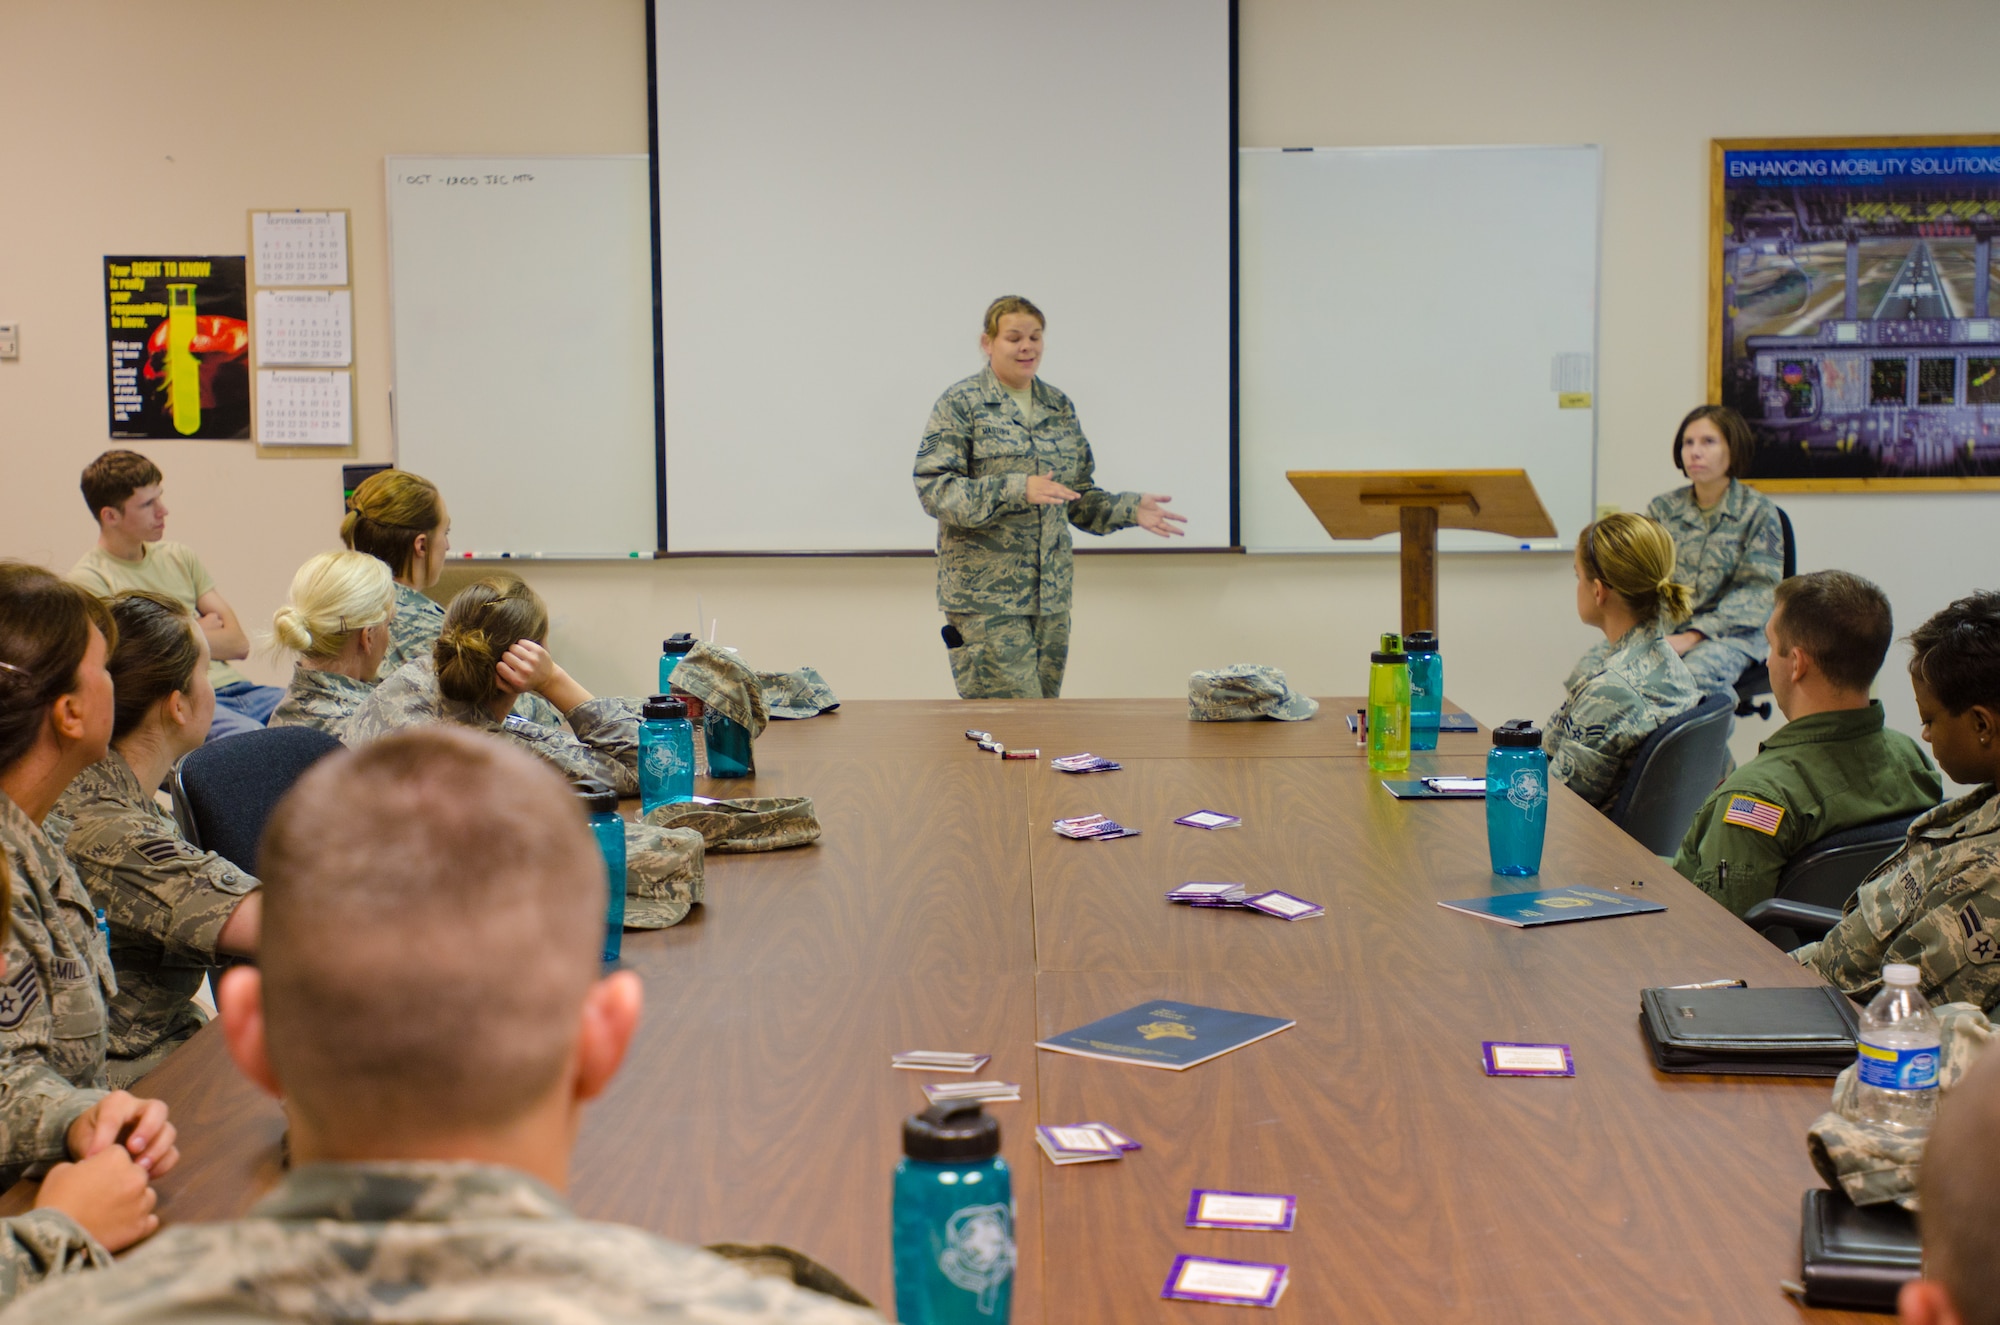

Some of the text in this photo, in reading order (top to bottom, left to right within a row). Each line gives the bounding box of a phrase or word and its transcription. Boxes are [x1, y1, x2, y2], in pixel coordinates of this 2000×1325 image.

[1730, 156, 2000, 177] ENHANCING MOBILITY SOLUTIONS
[406, 174, 432, 185] OCT
[131, 261, 162, 278] RIGHT
[163, 261, 177, 278] TO
[178, 261, 211, 278] KNOW
[119, 277, 145, 292] really
[110, 291, 132, 304] your
[110, 302, 168, 317] responsibility
[111, 316, 148, 328] to know.
